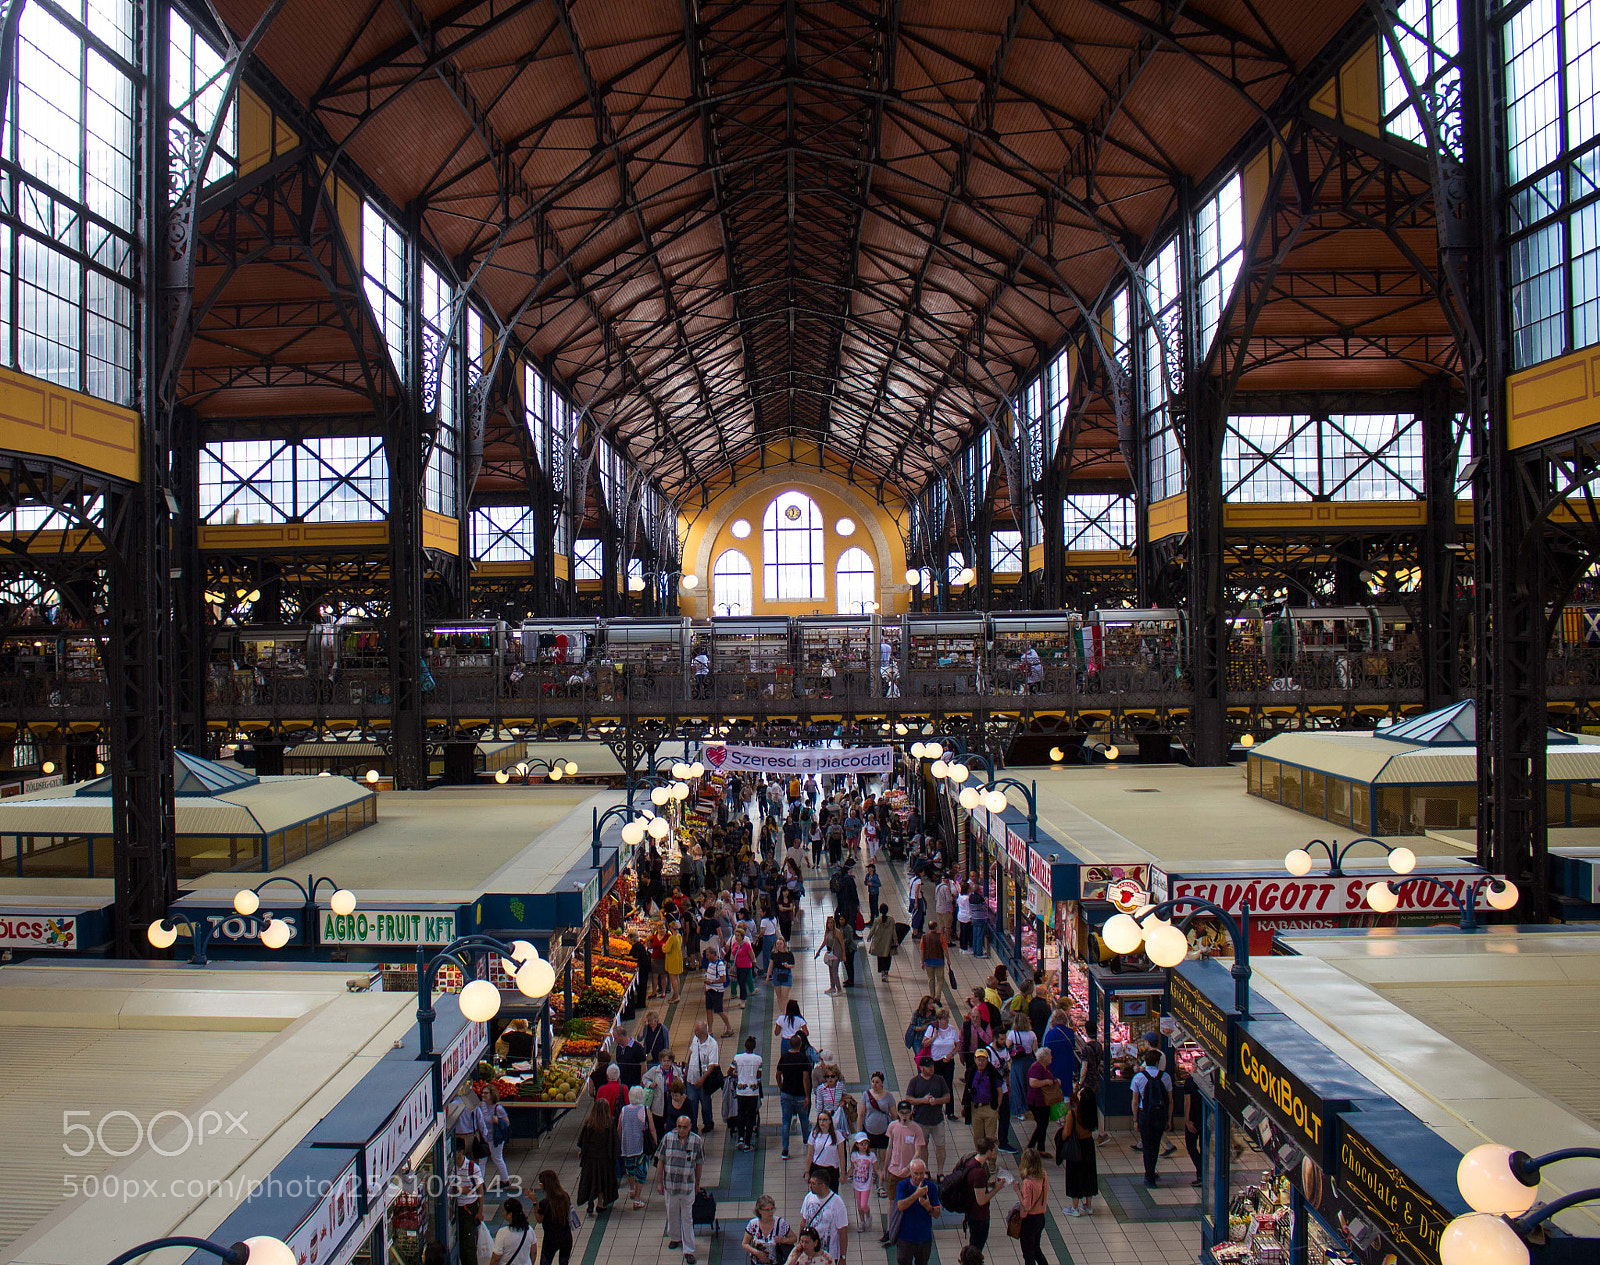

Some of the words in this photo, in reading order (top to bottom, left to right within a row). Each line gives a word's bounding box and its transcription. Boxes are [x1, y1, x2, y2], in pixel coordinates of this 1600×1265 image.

[731, 751, 797, 768] Szeresd
[801, 757, 811, 768] a
[816, 751, 891, 771] piacodat!
[1175, 880, 1336, 914] FELVÁGOTT
[1345, 877, 1494, 909] SZKÜZLE
[323, 913, 421, 942] AGRO-FRUIT
[425, 916, 457, 942] KFT.
[1256, 919, 1334, 932] KABANOS
[1341, 1143, 1398, 1212] Chocolate
[1404, 1201, 1413, 1224] &
[1419, 1213, 1440, 1253] Dri
